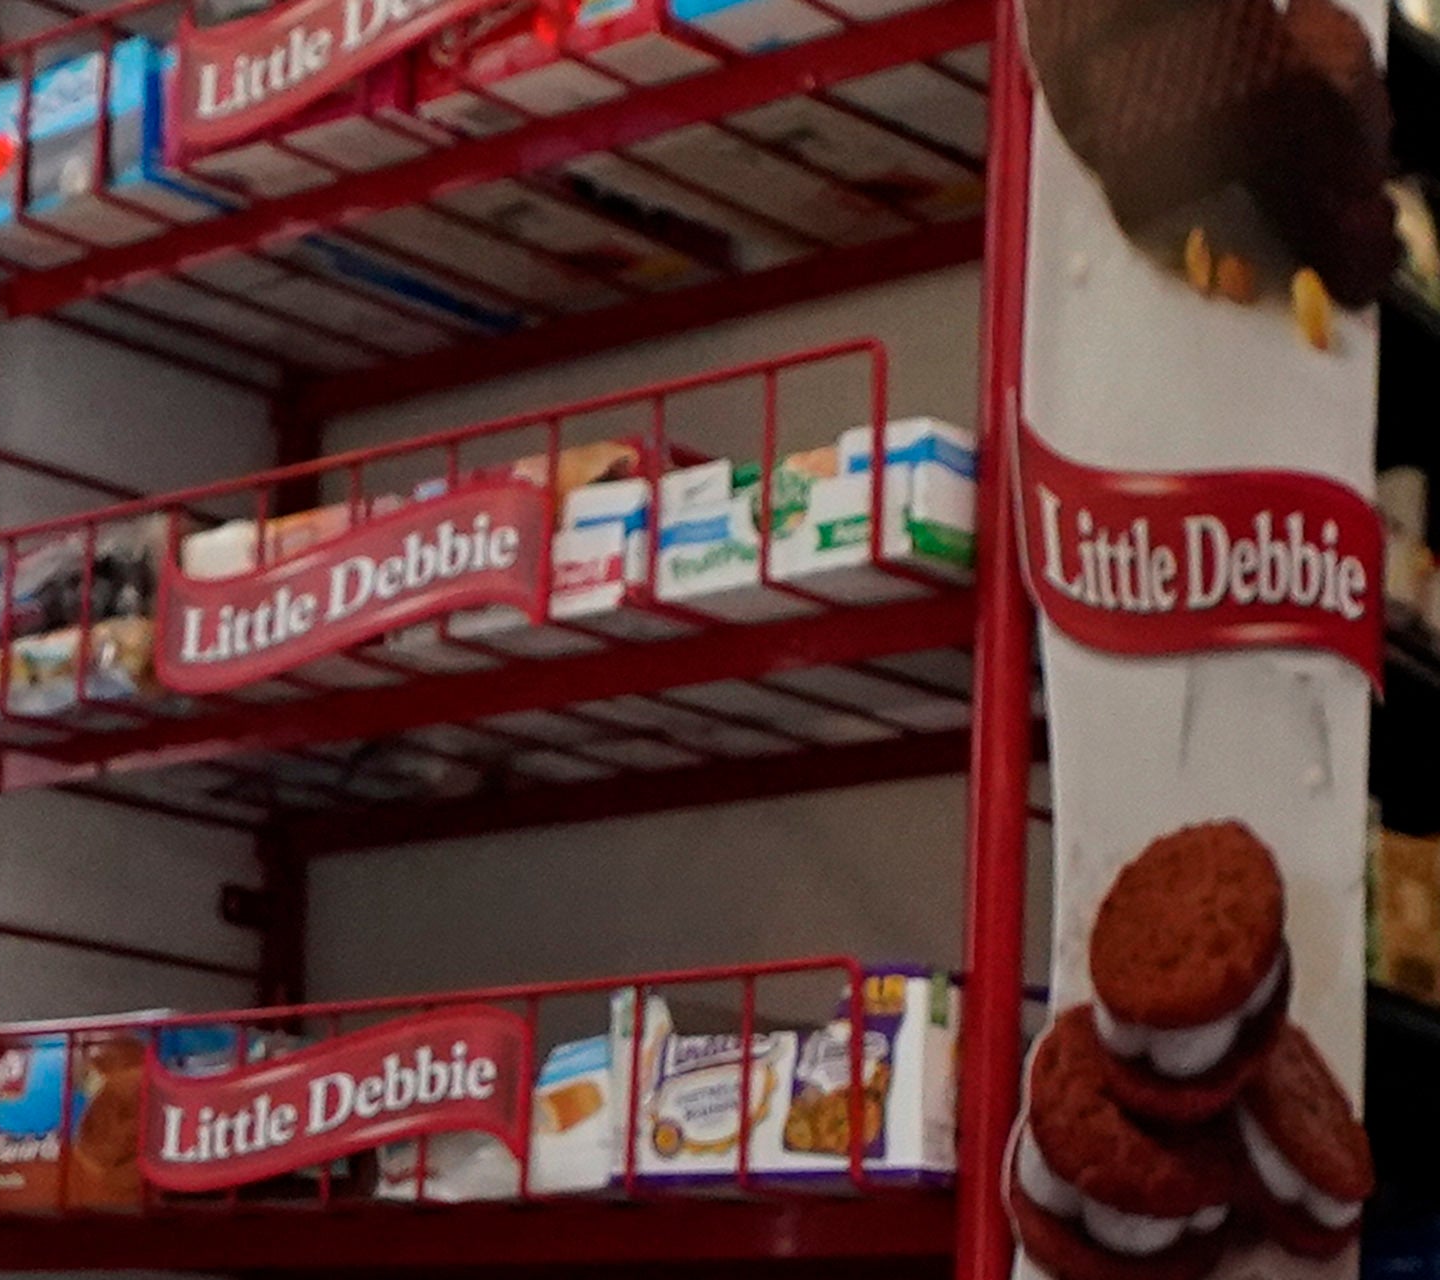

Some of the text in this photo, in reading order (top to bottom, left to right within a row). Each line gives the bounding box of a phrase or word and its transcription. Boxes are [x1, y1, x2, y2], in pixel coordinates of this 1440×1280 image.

[195, 24, 334, 120] Little
[180, 512, 520, 664] Little Debbie
[1036, 482, 1368, 620] Little Debbie
[160, 1040, 499, 1164] Little Debbie
